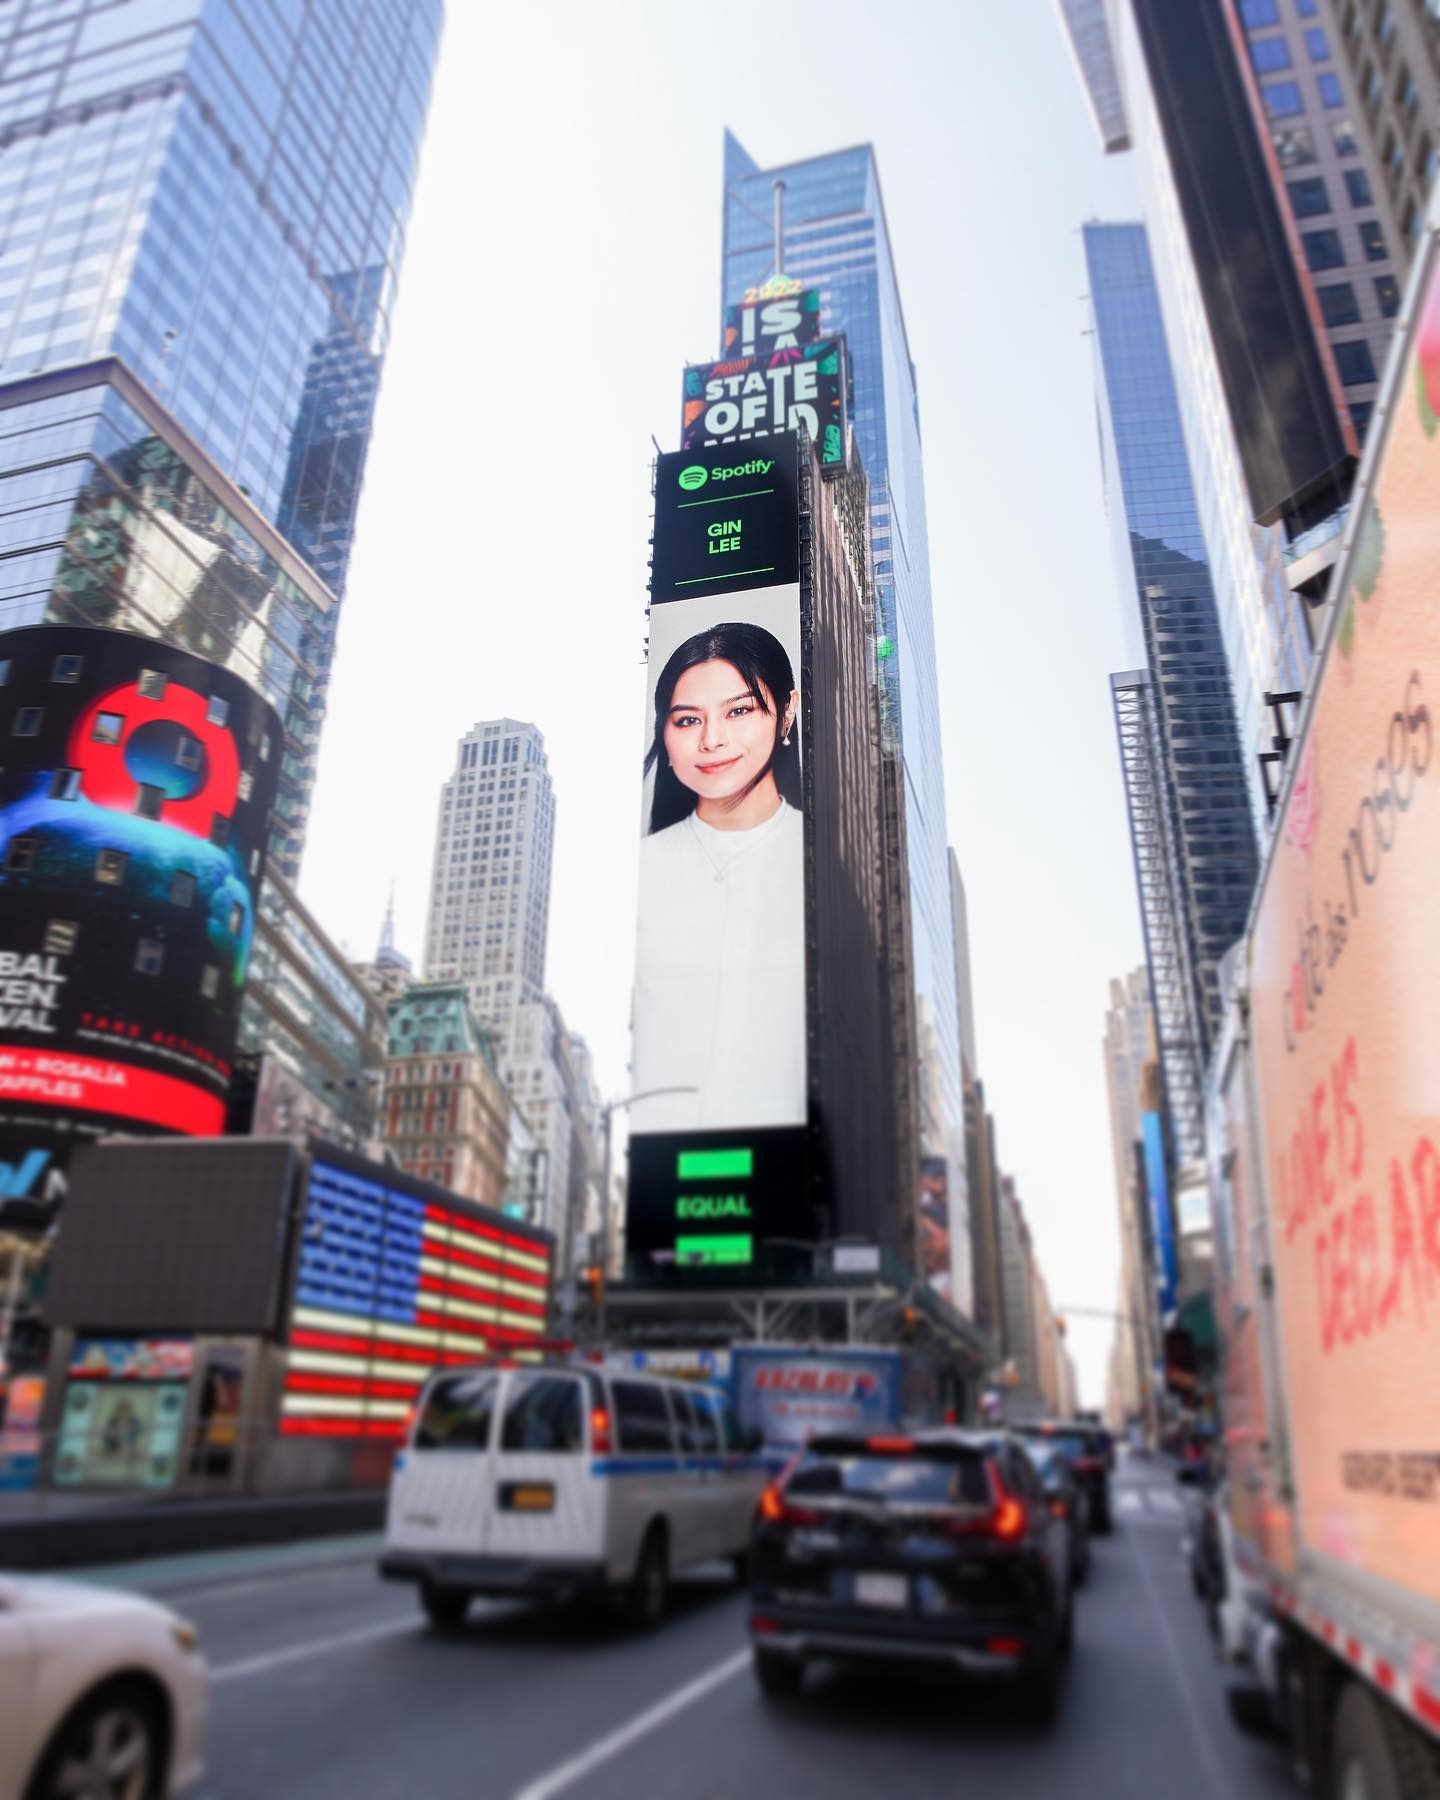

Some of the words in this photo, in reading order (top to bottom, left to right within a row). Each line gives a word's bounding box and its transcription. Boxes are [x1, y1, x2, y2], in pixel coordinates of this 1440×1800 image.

[705, 360, 818, 426] STATE
[704, 401, 767, 435] OF
[711, 459, 772, 481] Spotify
[707, 520, 742, 537] GIN
[709, 537, 741, 554] LEE
[677, 1195, 750, 1219] EQUAL
